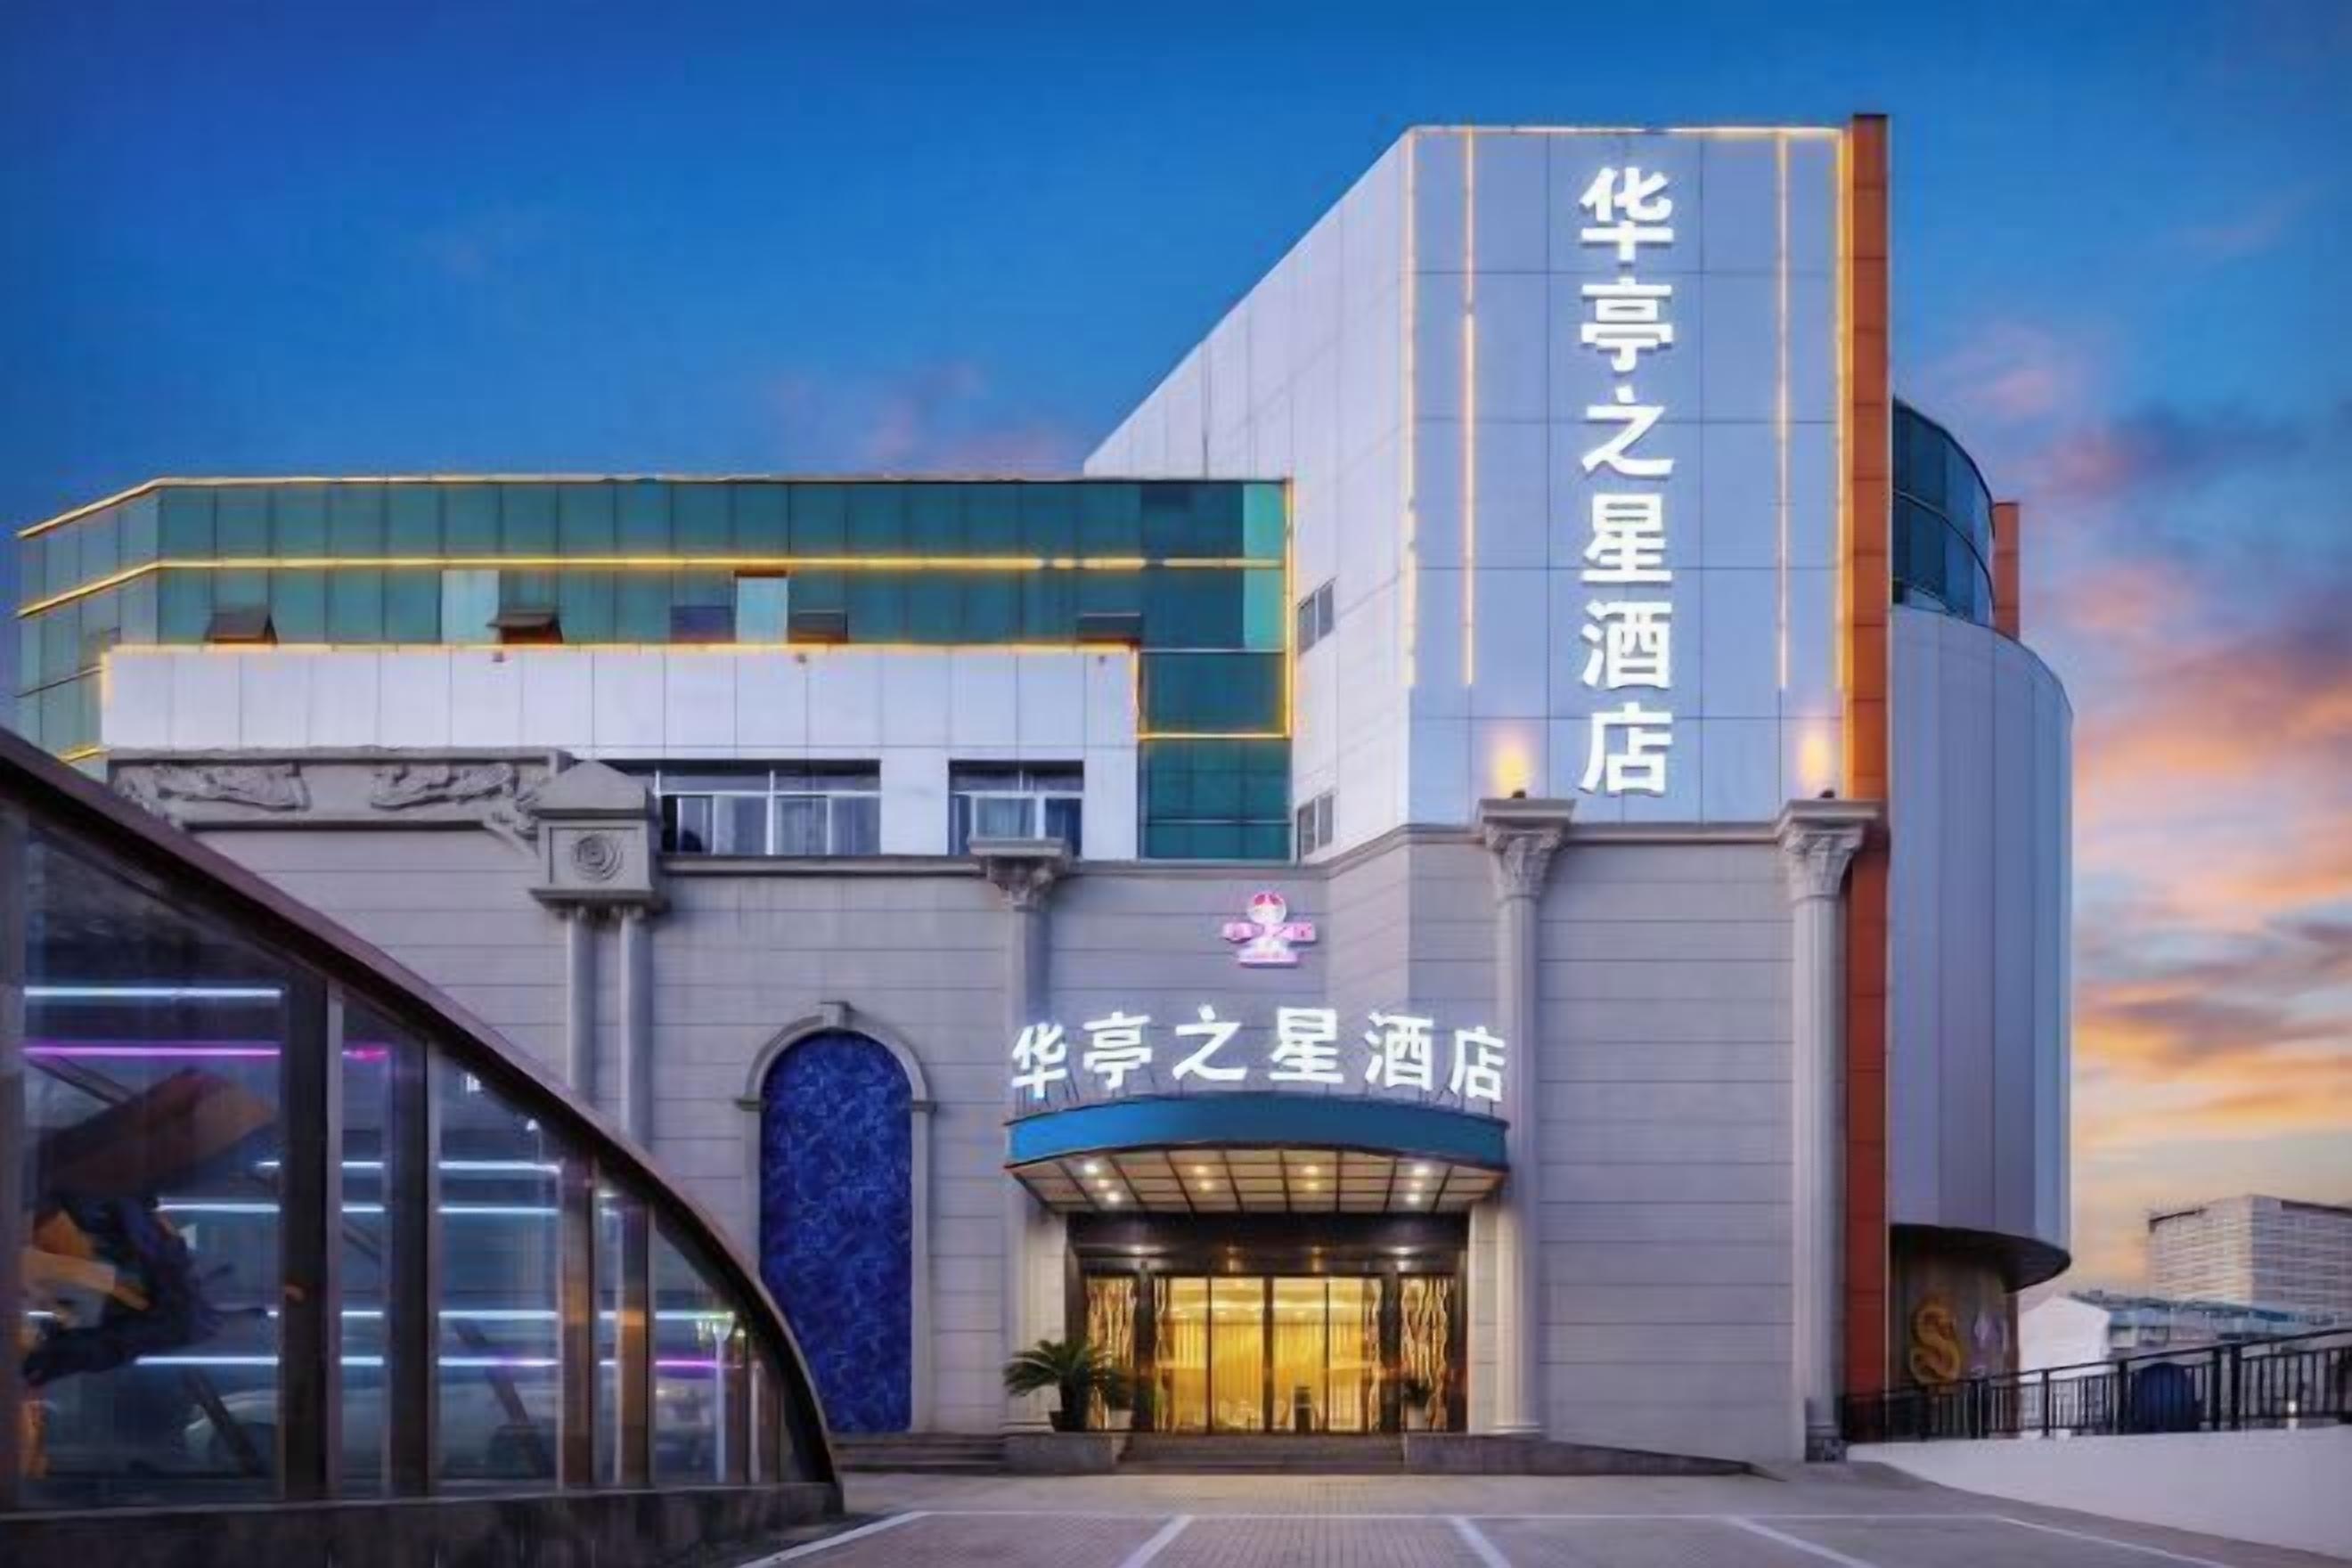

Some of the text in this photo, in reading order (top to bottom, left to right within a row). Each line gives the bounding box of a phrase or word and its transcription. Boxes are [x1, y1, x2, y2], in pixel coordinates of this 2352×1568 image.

[1580, 167, 1674, 794] 华亭之星酒店
[1011, 1005, 1507, 1101] 华亭之星酒店
